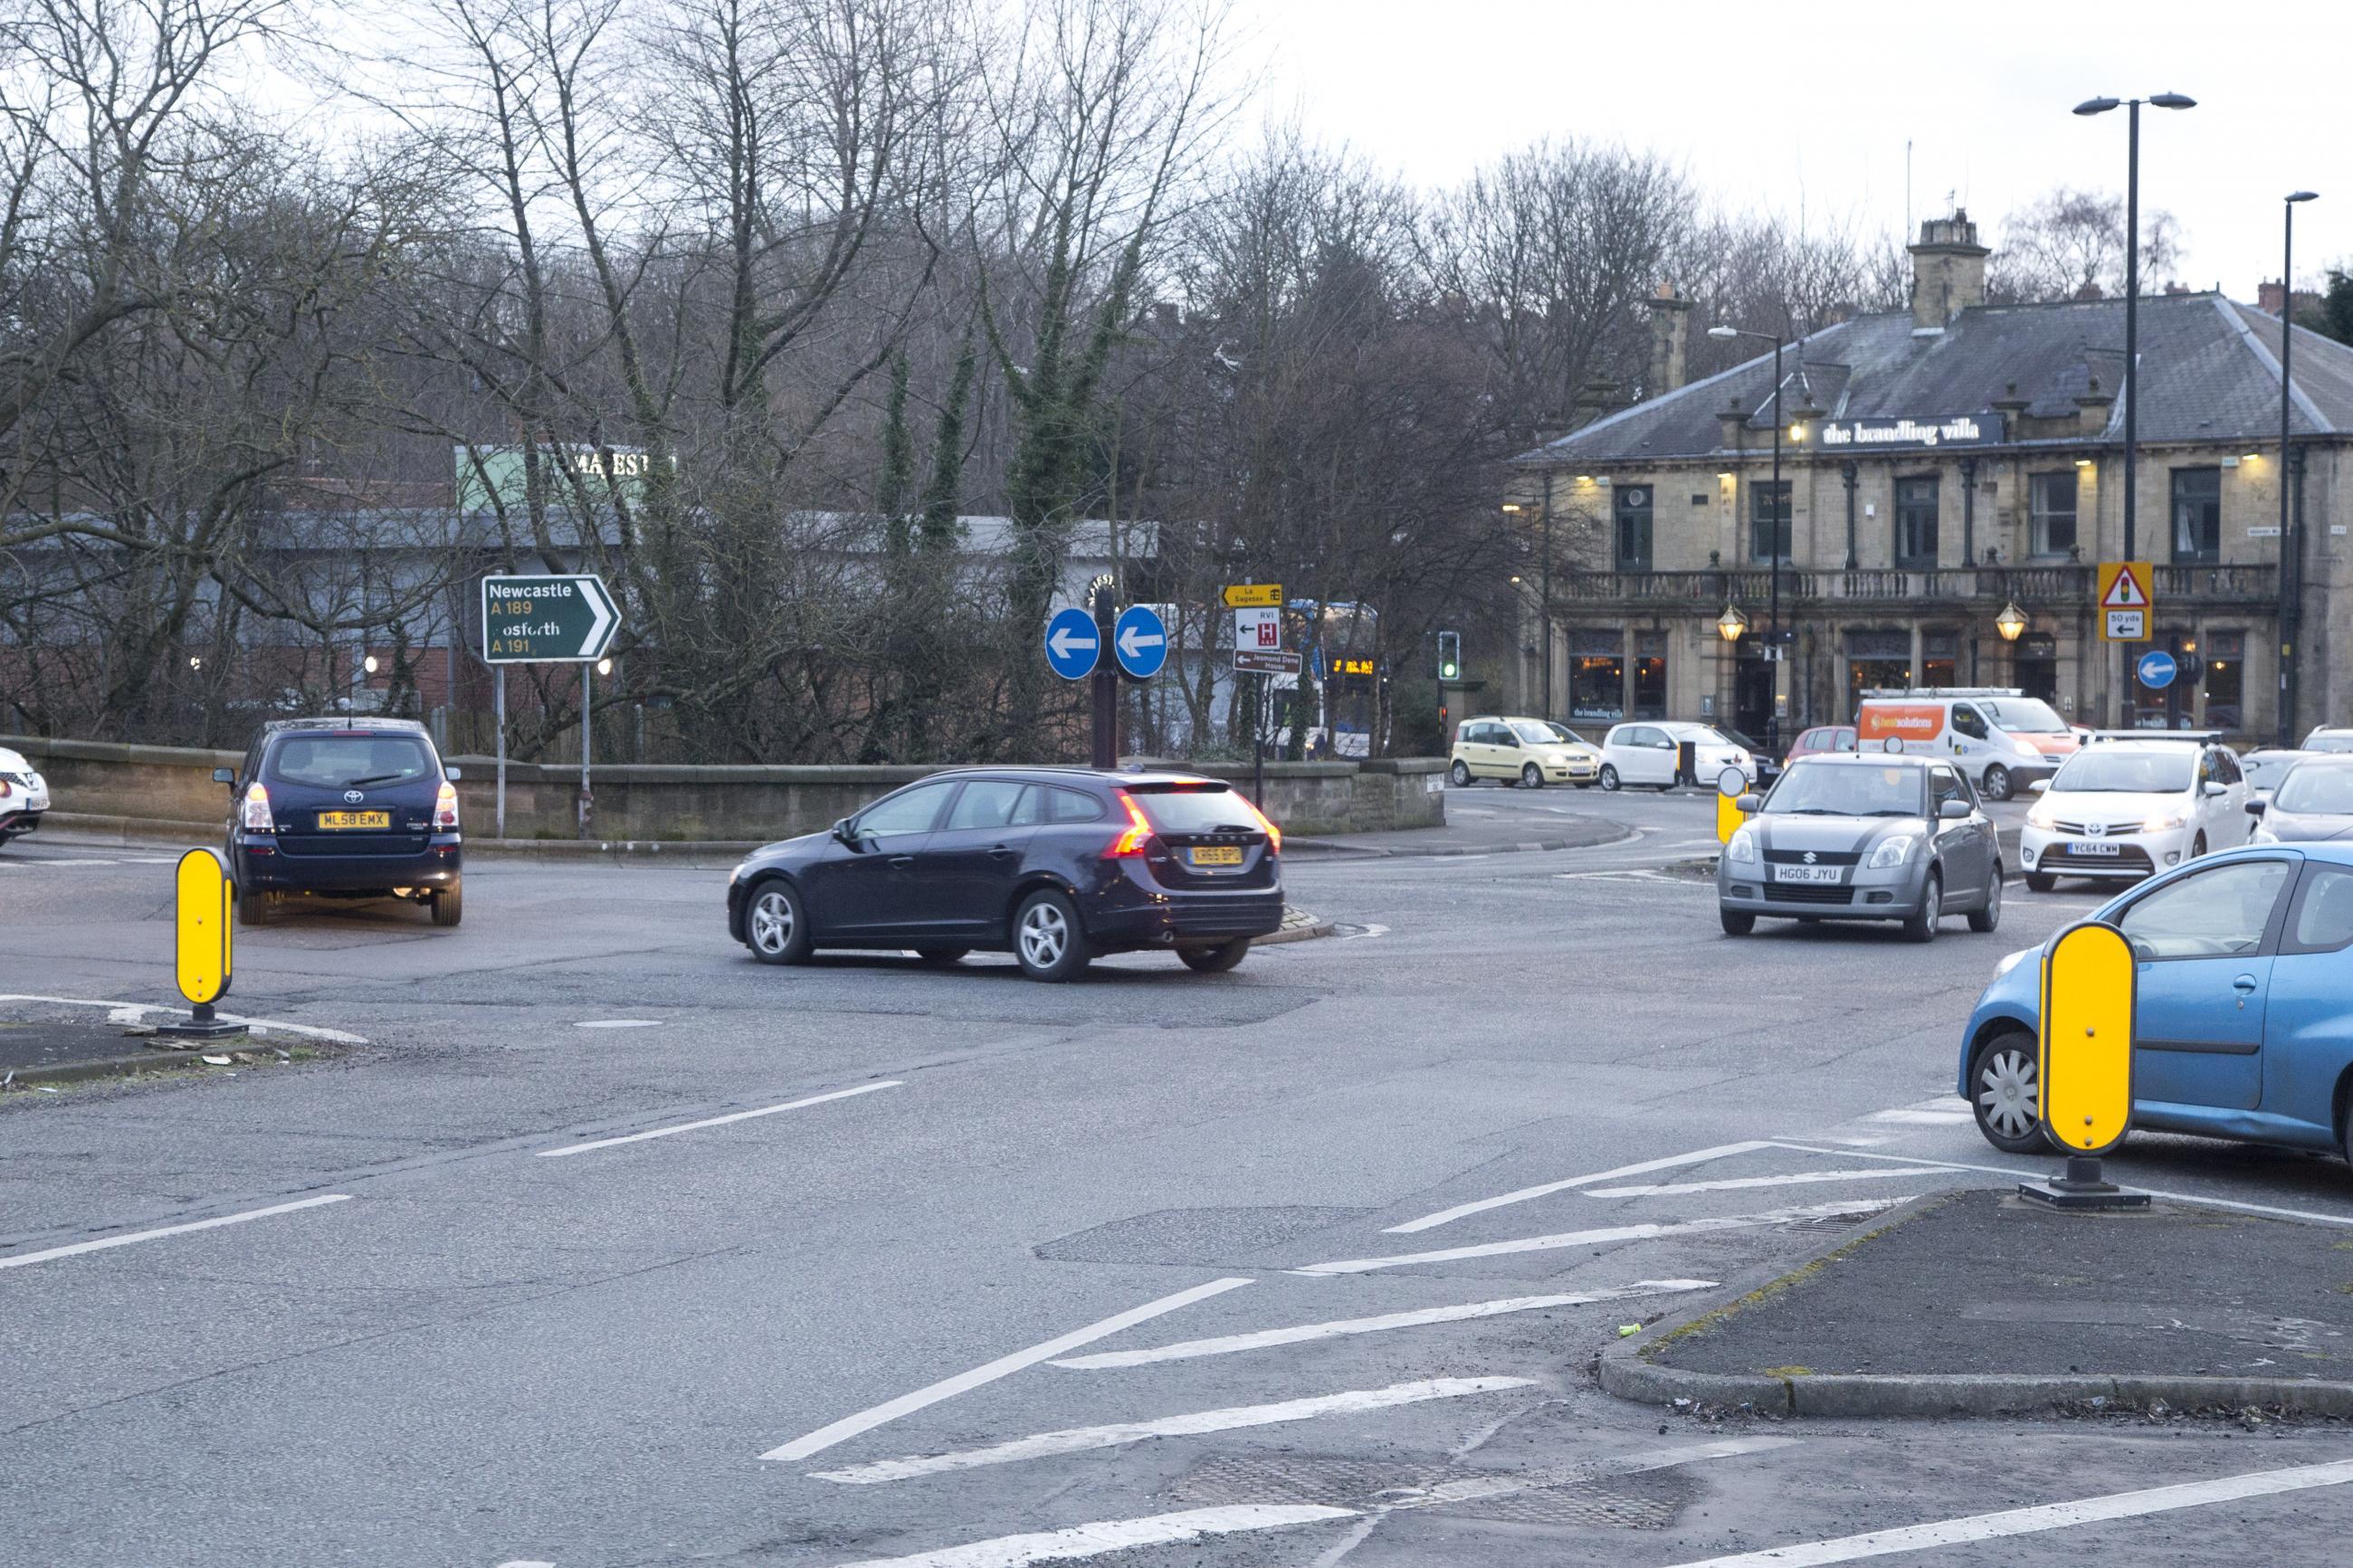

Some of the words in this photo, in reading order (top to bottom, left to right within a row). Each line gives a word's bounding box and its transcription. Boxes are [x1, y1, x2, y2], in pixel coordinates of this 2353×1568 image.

[1823, 423, 1851, 444] the
[1854, 420, 1938, 446] brandling
[1940, 417, 1979, 441] villa
[490, 584, 572, 598] Newcastle
[491, 602, 502, 615] A
[506, 601, 532, 615] 189
[1260, 611, 1274, 619] RVI
[2110, 614, 2123, 622] 50
[2124, 614, 2140, 622] yds
[491, 640, 503, 652] A
[507, 639, 530, 653] 191
[1253, 653, 1281, 663] Jesmond
[1281, 656, 1300, 664] Dene
[1264, 662, 1286, 670] House
[324, 813, 357, 826] ML58
[359, 813, 384, 825] EMX
[2074, 843, 2097, 853] YC64
[1779, 868, 1811, 879] HG06
[1814, 869, 1837, 880] JYU
